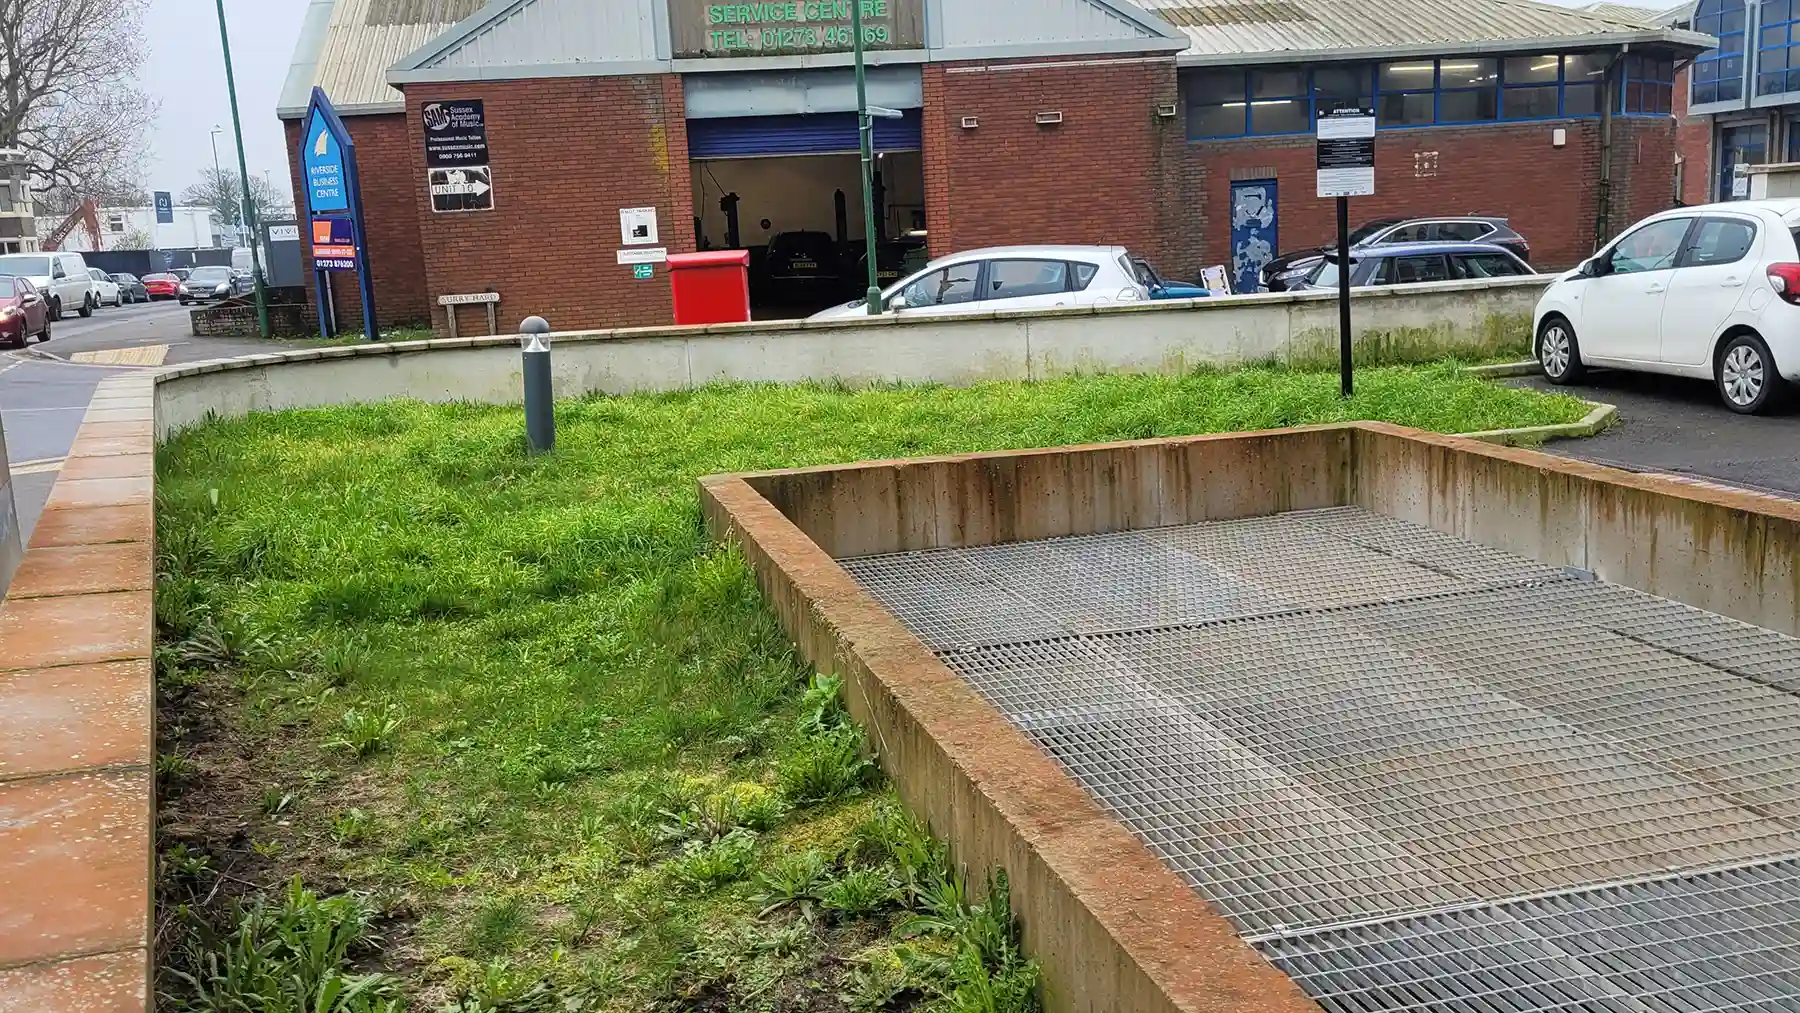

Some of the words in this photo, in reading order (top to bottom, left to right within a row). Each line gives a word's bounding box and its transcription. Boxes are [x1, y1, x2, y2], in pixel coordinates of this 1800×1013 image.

[709, 2, 797, 23] SERVICE
[710, 31, 752, 49] TEL:
[762, 28, 816, 47] 01273
[311, 164, 338, 175] RIVERSIDE
[313, 177, 338, 186] BUSINESS
[317, 188, 339, 198] CENTRE
[462, 184, 473, 192] 10
